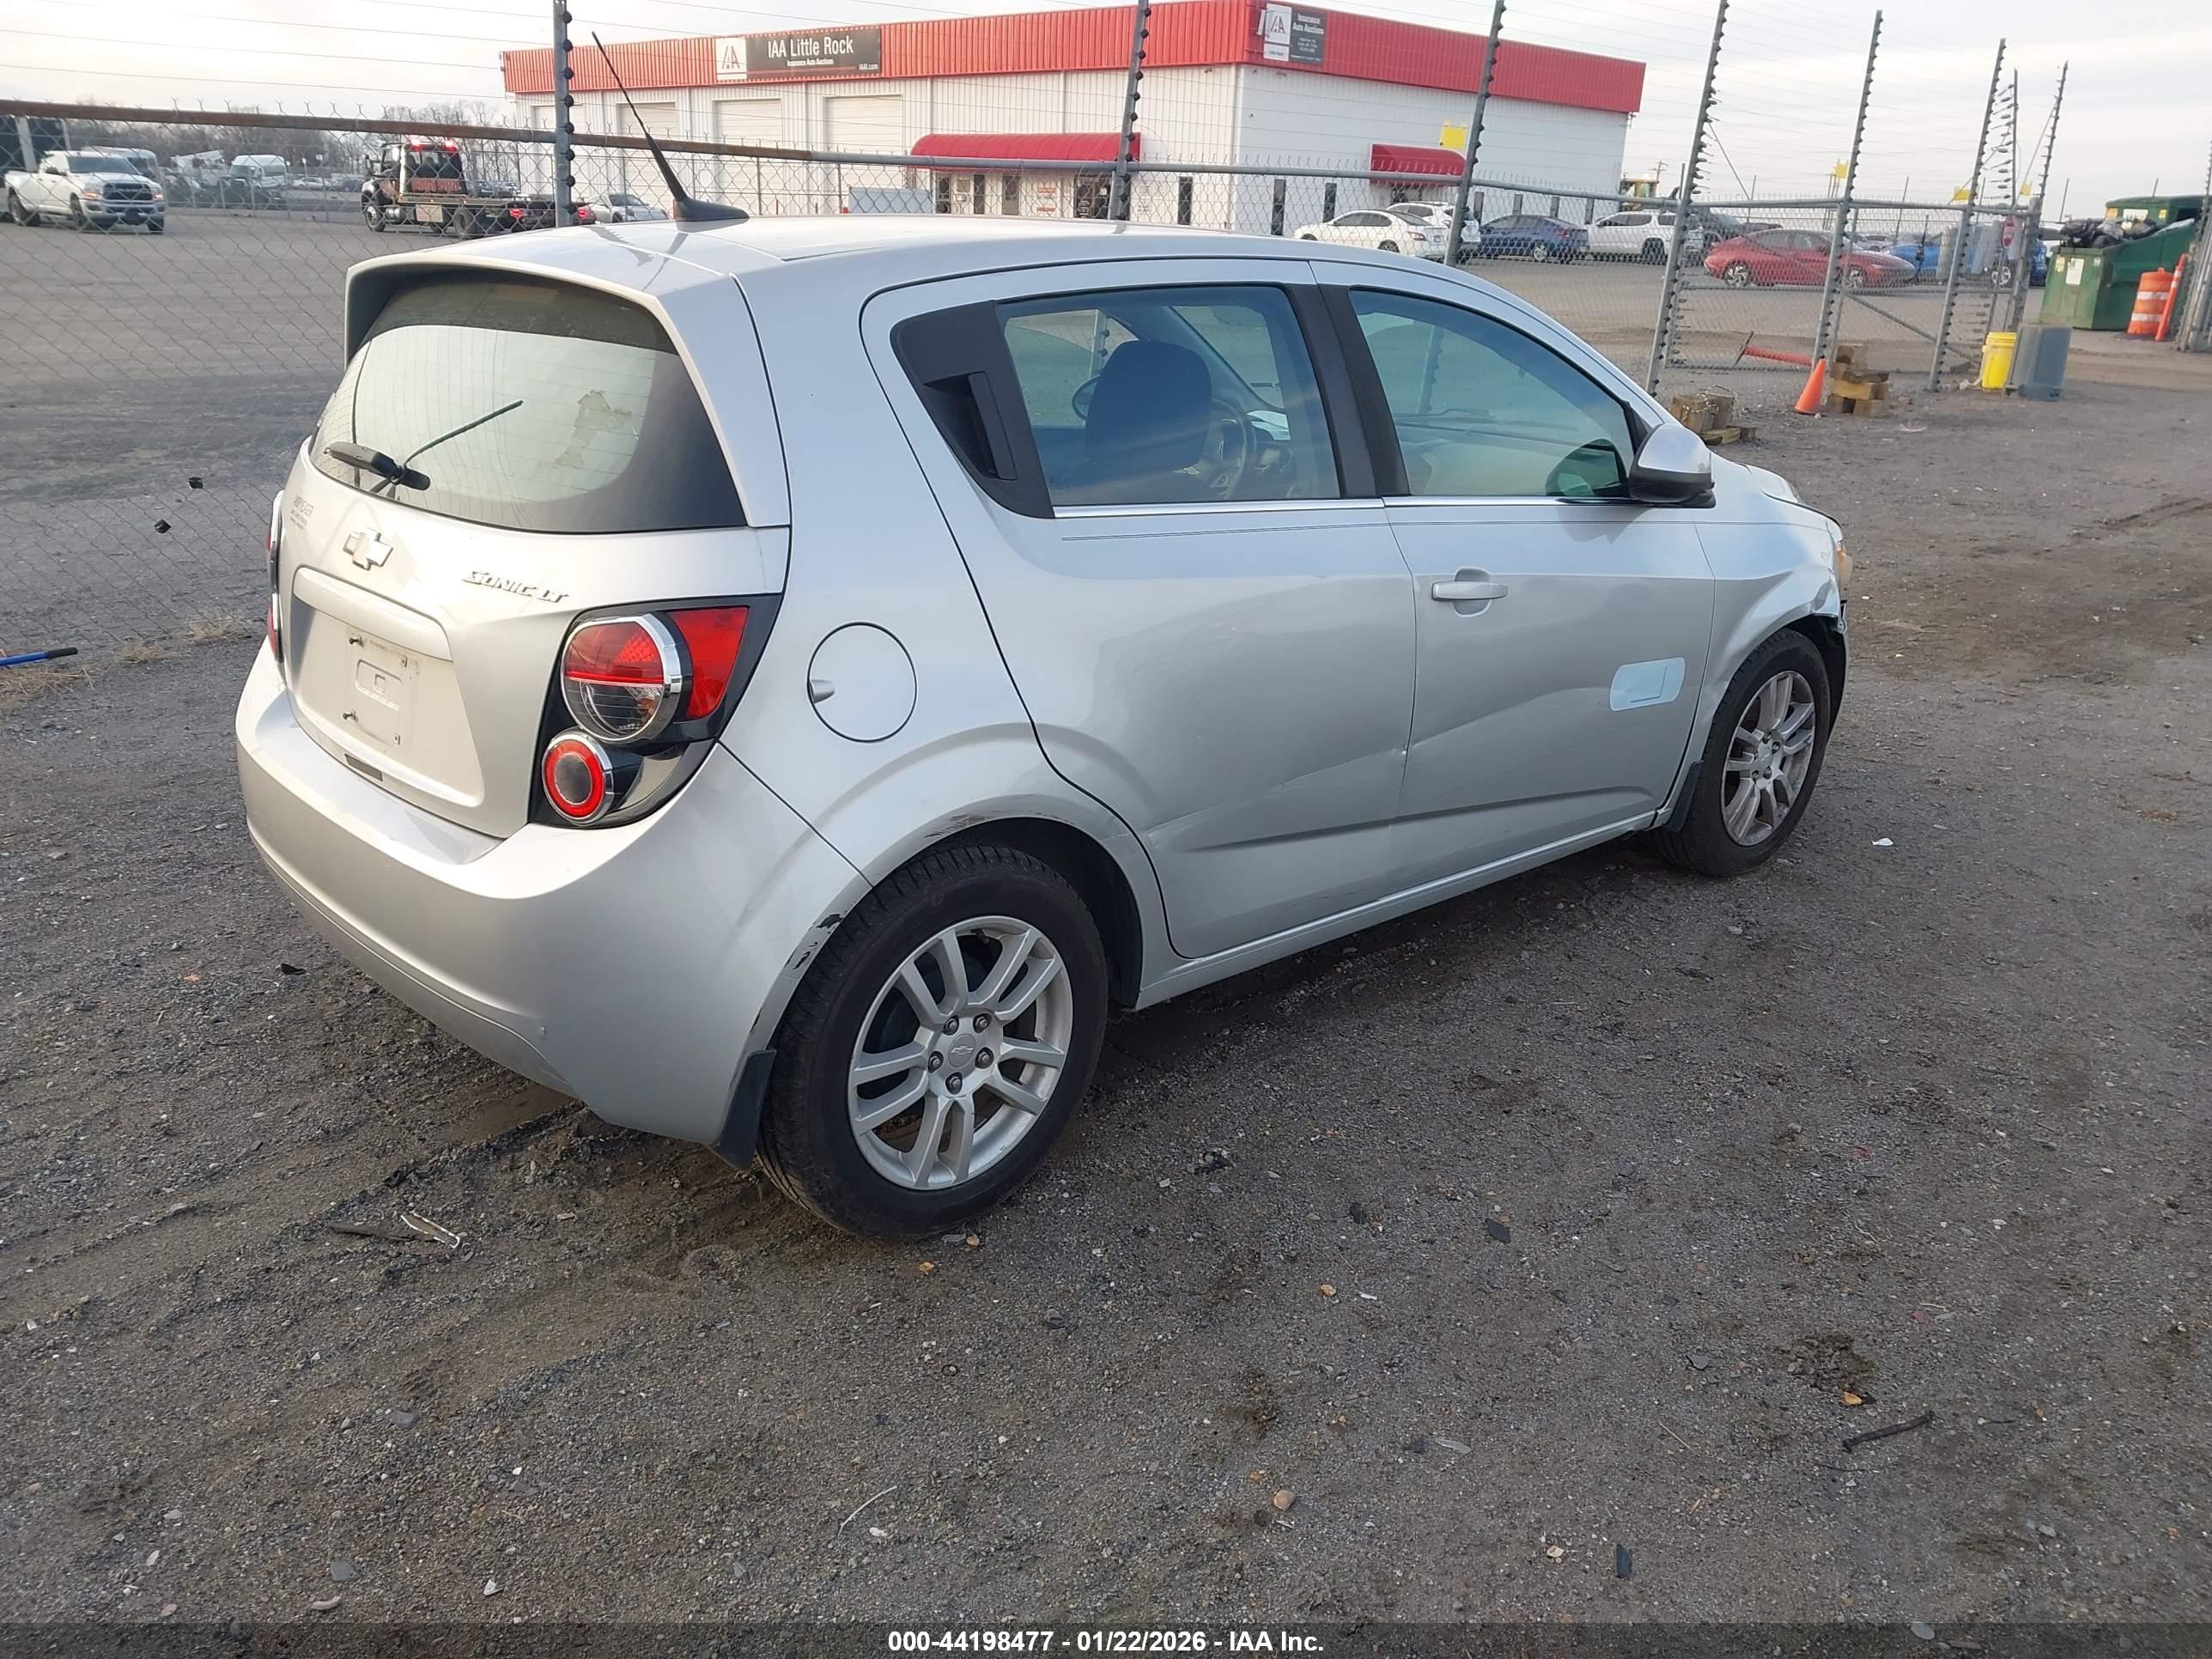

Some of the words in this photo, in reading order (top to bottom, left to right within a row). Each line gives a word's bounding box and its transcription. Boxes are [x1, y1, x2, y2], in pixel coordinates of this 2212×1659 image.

[768, 40, 787, 58] IAA
[790, 38, 819, 57] Little
[824, 35, 854, 55] Rock
[461, 570, 538, 597] SONIC
